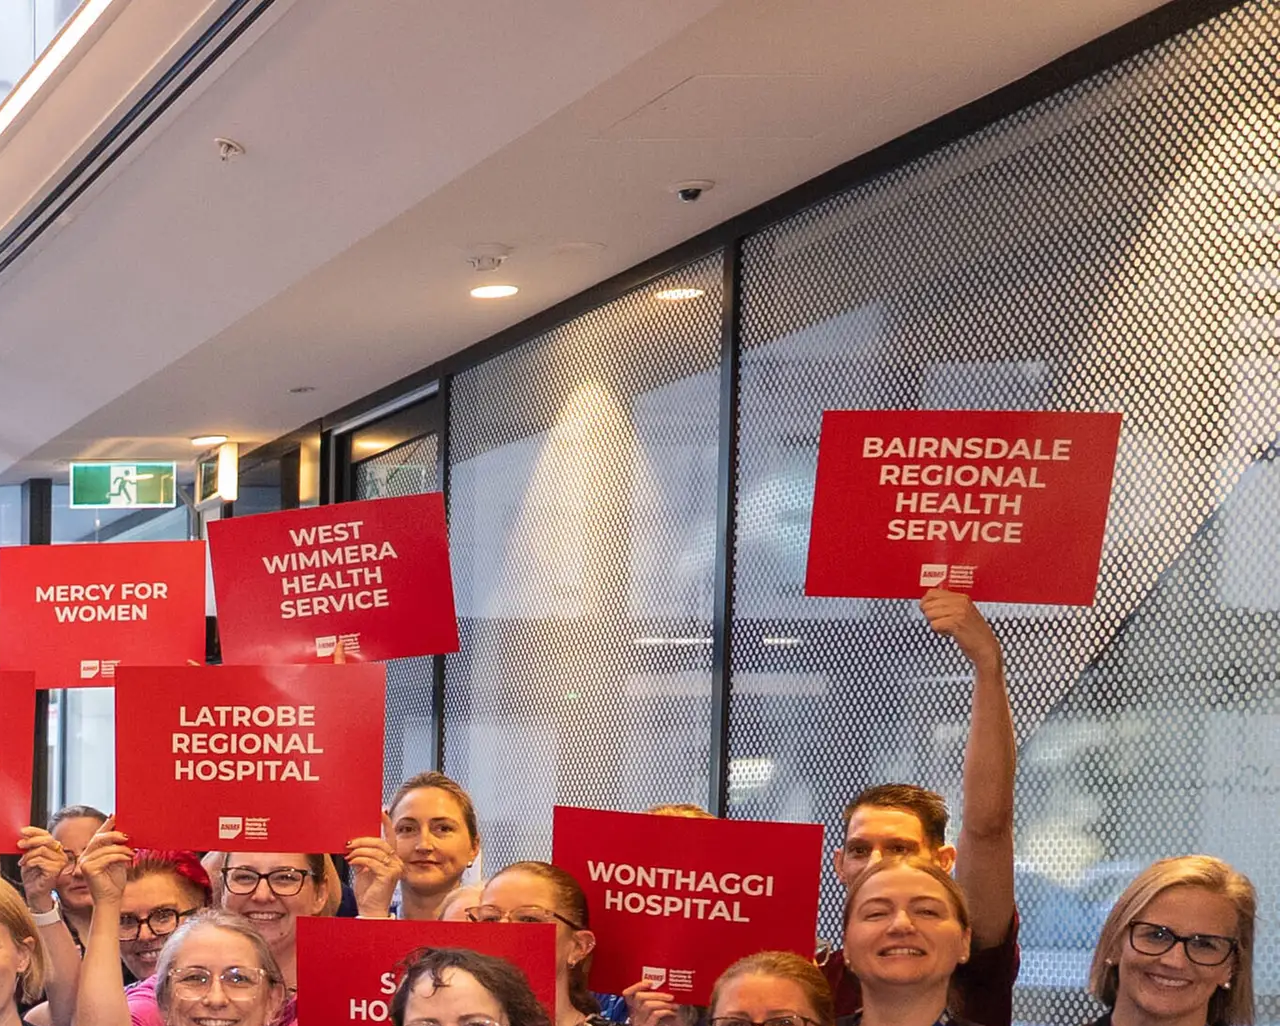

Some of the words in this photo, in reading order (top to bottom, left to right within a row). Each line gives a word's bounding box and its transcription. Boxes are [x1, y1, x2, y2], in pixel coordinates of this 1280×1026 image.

[862, 436, 1073, 461] BAIRNSDALE
[879, 464, 1047, 489] REGIONAL
[895, 492, 1023, 516] HEALTH
[288, 520, 364, 547] WEST
[886, 519, 1024, 544] SERVICE
[261, 541, 398, 575] WIMMERA
[35, 583, 116, 603] MERCY
[121, 582, 168, 600] FOR
[281, 565, 383, 596] HEALTH
[54, 603, 148, 623] WOMEN
[280, 588, 390, 619] SERVICE
[179, 705, 316, 727] LATROBE
[172, 732, 324, 754] REGIONAL
[175, 759, 320, 782] HOSPITAL
[587, 860, 774, 897] WONTHAGGI
[605, 889, 750, 923] HOSPITAL
